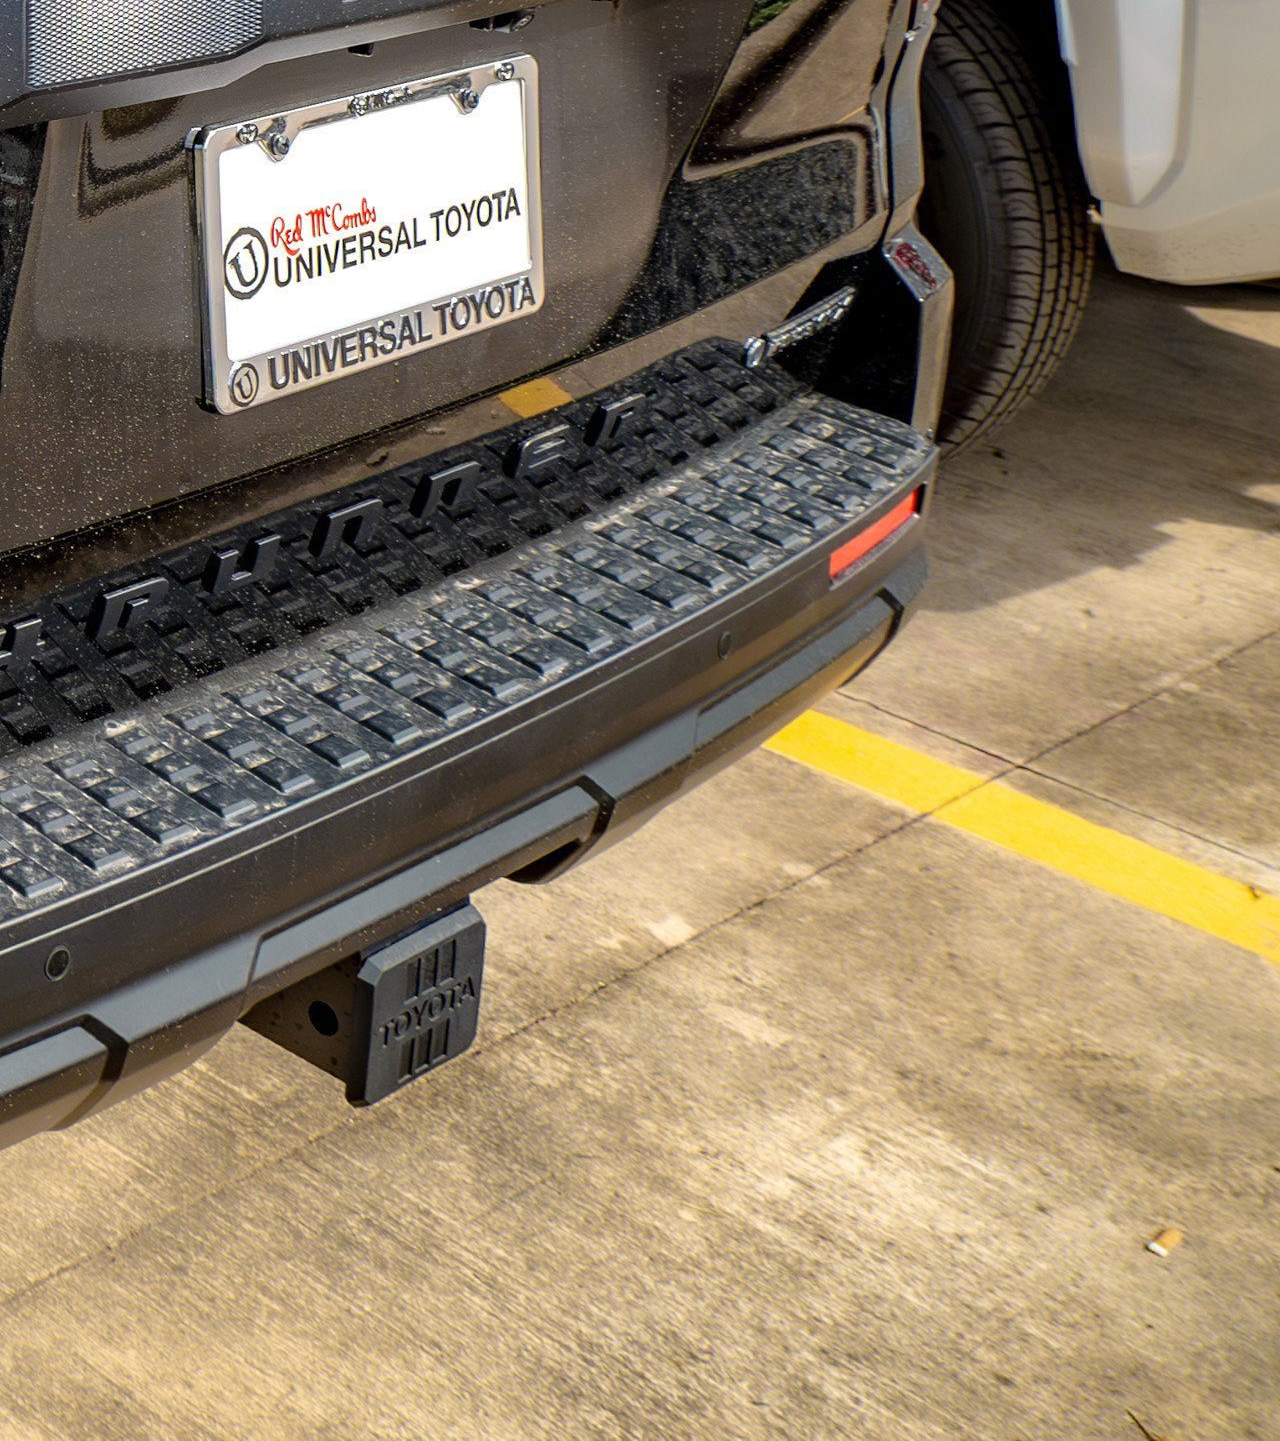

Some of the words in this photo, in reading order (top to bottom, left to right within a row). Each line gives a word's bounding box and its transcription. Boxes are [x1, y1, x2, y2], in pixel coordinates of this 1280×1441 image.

[270, 208, 304, 256] Red
[304, 197, 377, 239] McCombs
[273, 220, 427, 288] UNIVERSAL
[429, 187, 521, 242] TOYOTA
[267, 310, 433, 390] UNIVERSAL
[433, 276, 536, 336] TOYOTA
[379, 976, 476, 1049] TOYOTA
